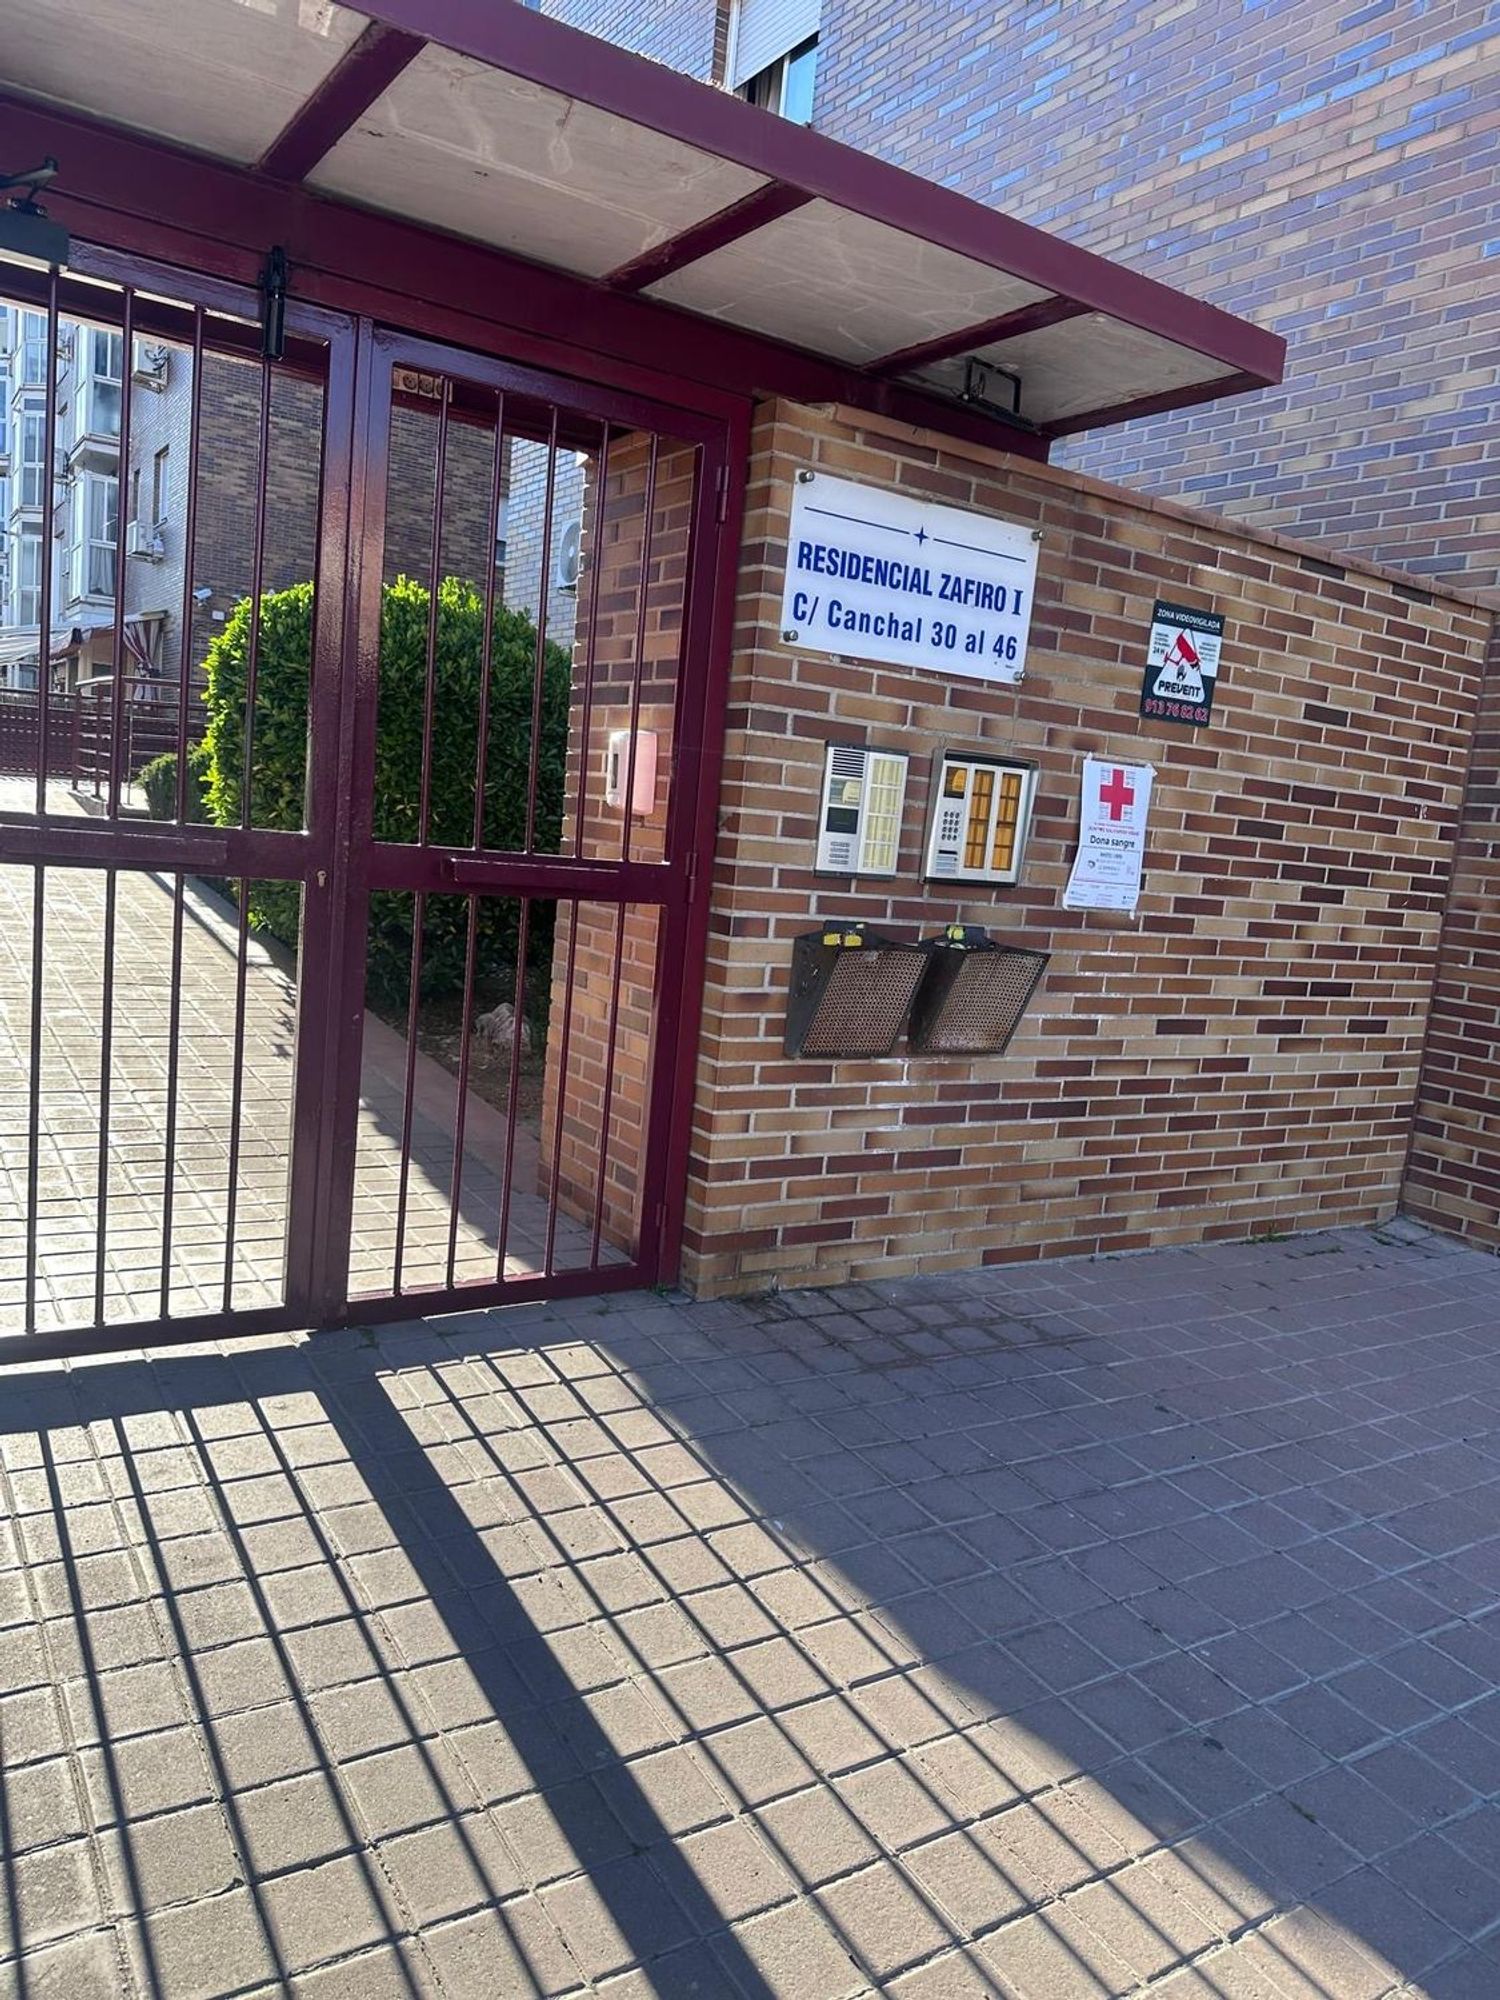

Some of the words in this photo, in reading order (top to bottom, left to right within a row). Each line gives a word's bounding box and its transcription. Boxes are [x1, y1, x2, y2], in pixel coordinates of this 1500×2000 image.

[797, 541, 933, 597] RESIDENCIAL
[938, 573, 1007, 612] ZAFIRO
[1011, 589, 1024, 616] I
[793, 592, 819, 626] C/
[827, 599, 922, 643] Canchal
[931, 621, 957, 649] 30
[965, 630, 985, 655] al
[993, 634, 1018, 661] 46
[1157, 608, 1175, 619] ZONA
[1175, 613, 1220, 629] VIDEOVIGILADA
[1158, 680, 1201, 698] PREVENT
[1090, 835, 1110, 846] Dona
[1111, 838, 1135, 850] sangre
